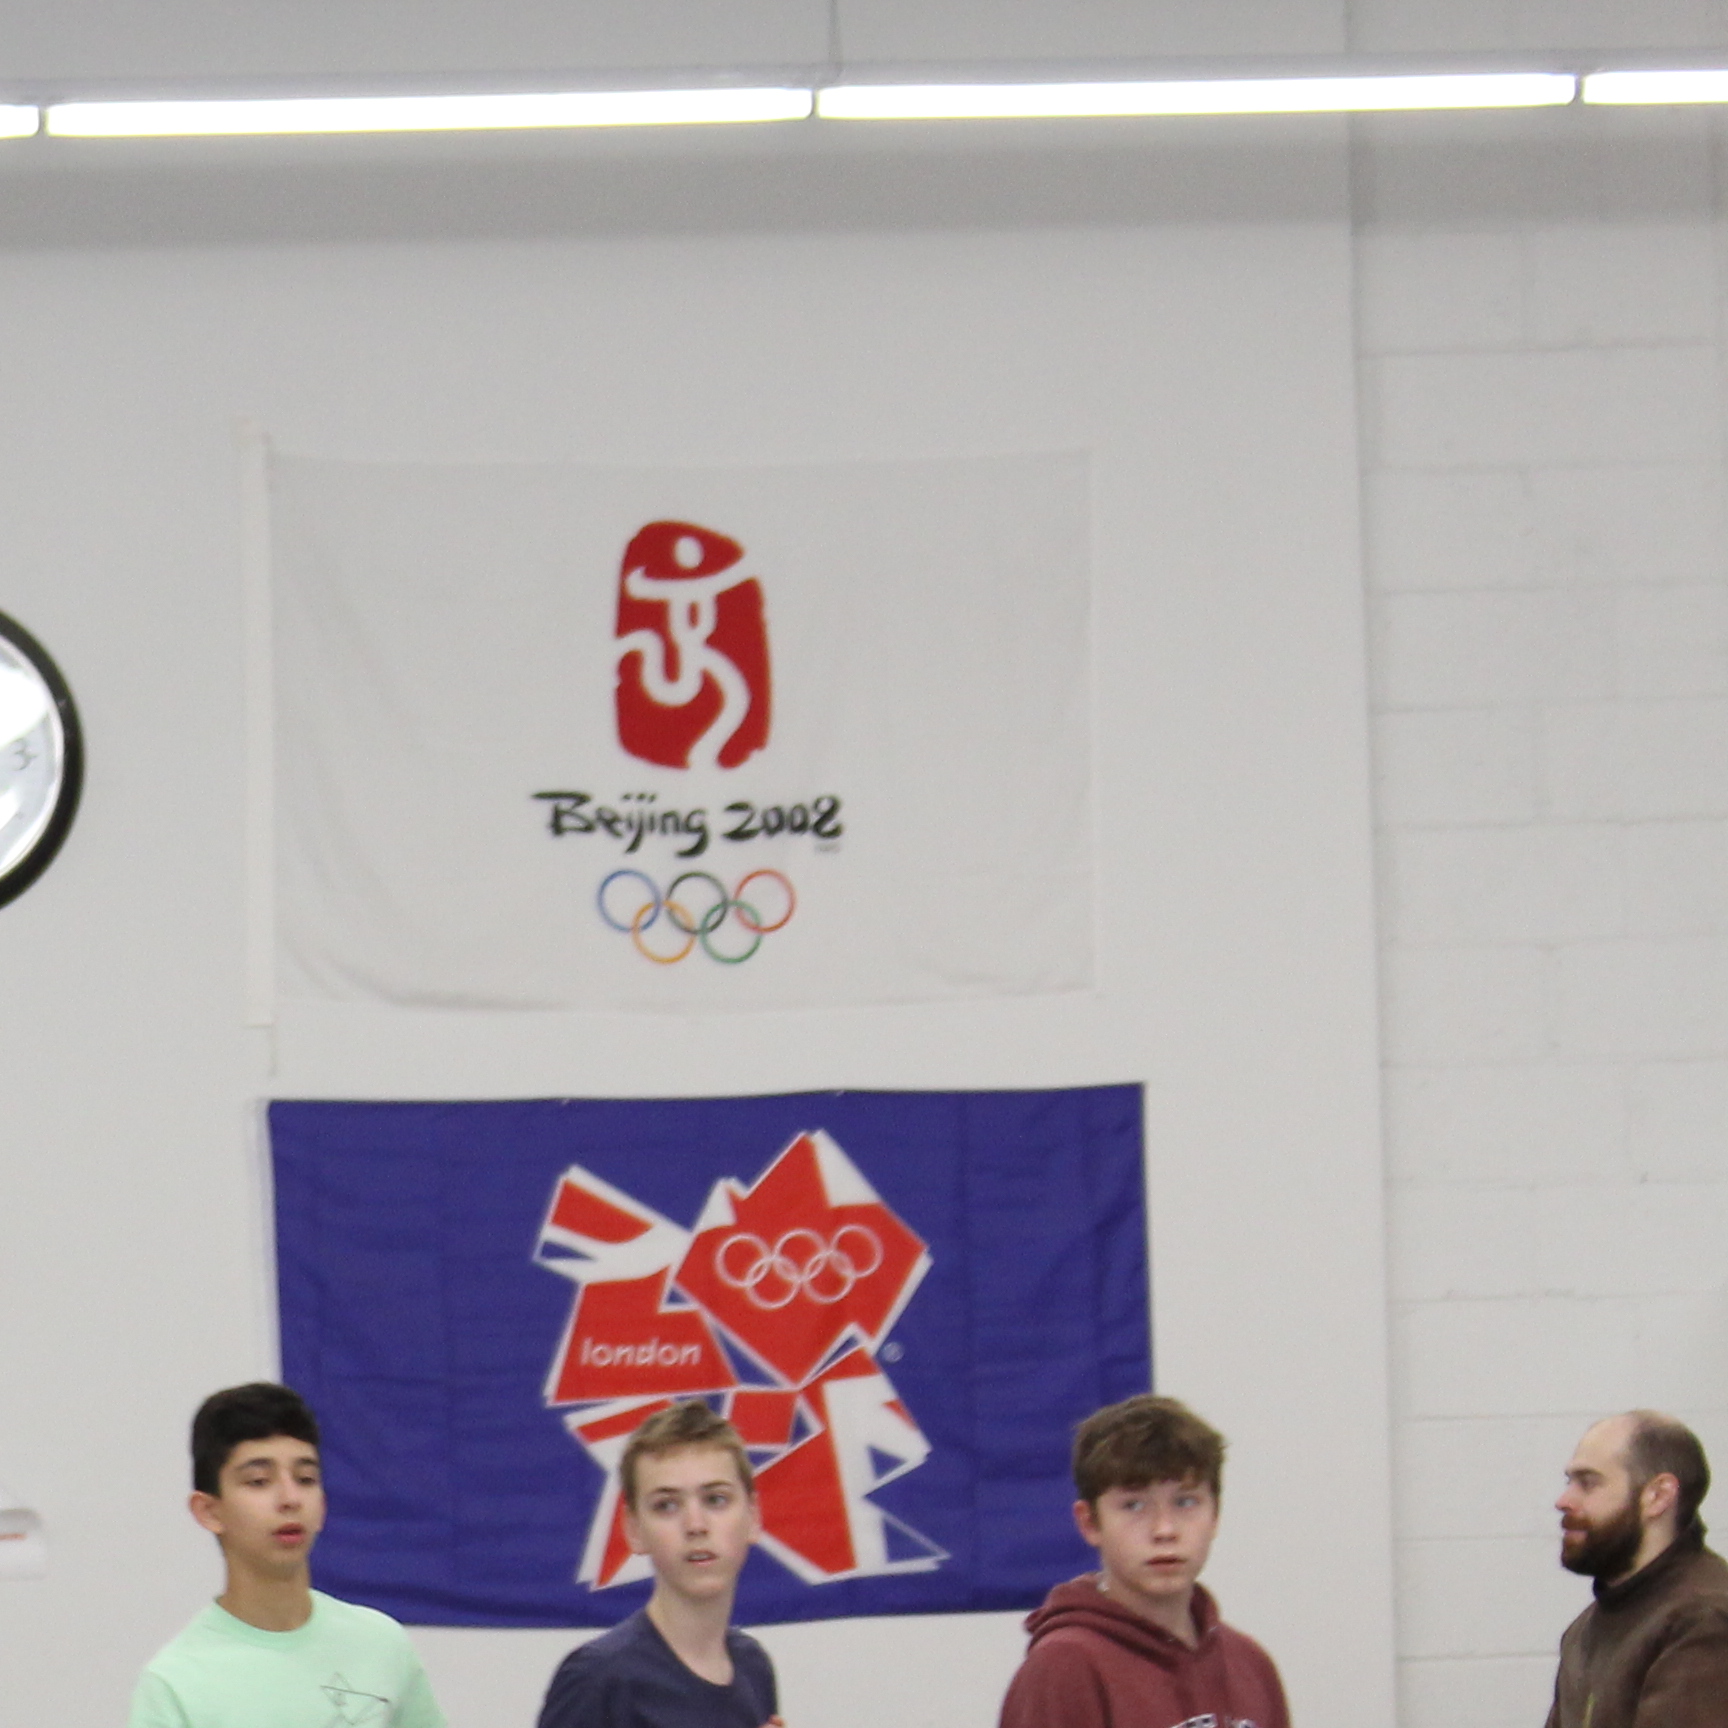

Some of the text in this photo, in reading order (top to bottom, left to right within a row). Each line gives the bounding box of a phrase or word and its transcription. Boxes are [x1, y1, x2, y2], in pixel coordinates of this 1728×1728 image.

[531, 790, 844, 857] Beijing 2008
[579, 1335, 701, 1369] london
